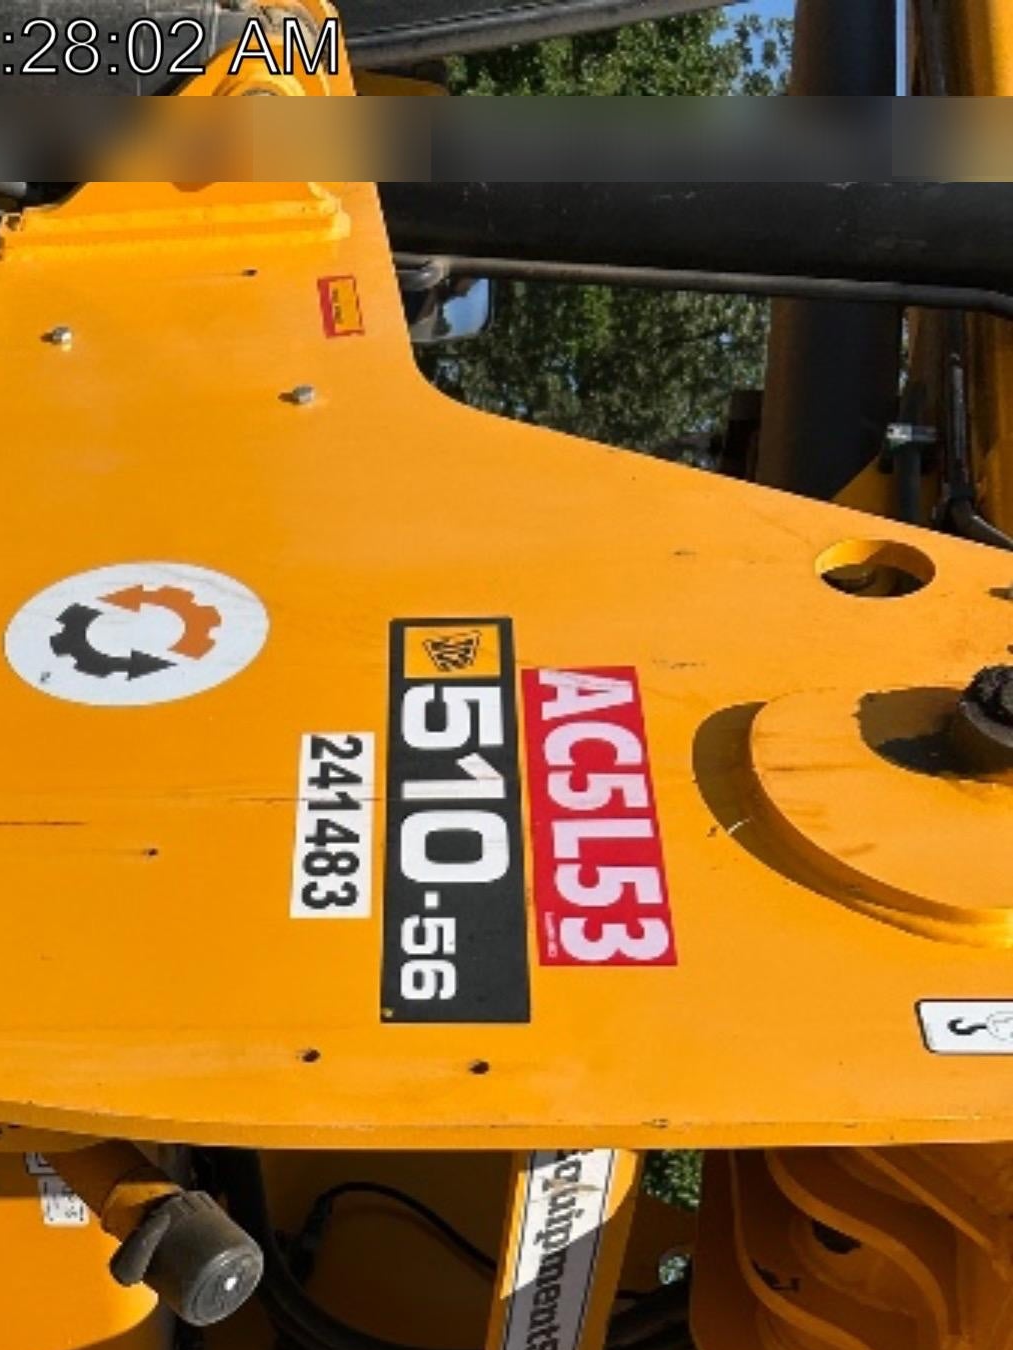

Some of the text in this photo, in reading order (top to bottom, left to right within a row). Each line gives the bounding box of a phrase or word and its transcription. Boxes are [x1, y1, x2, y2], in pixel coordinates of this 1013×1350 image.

[300, 735, 364, 910] 241483
[399, 683, 511, 1001] 510-56
[538, 669, 670, 963] AC5L53
